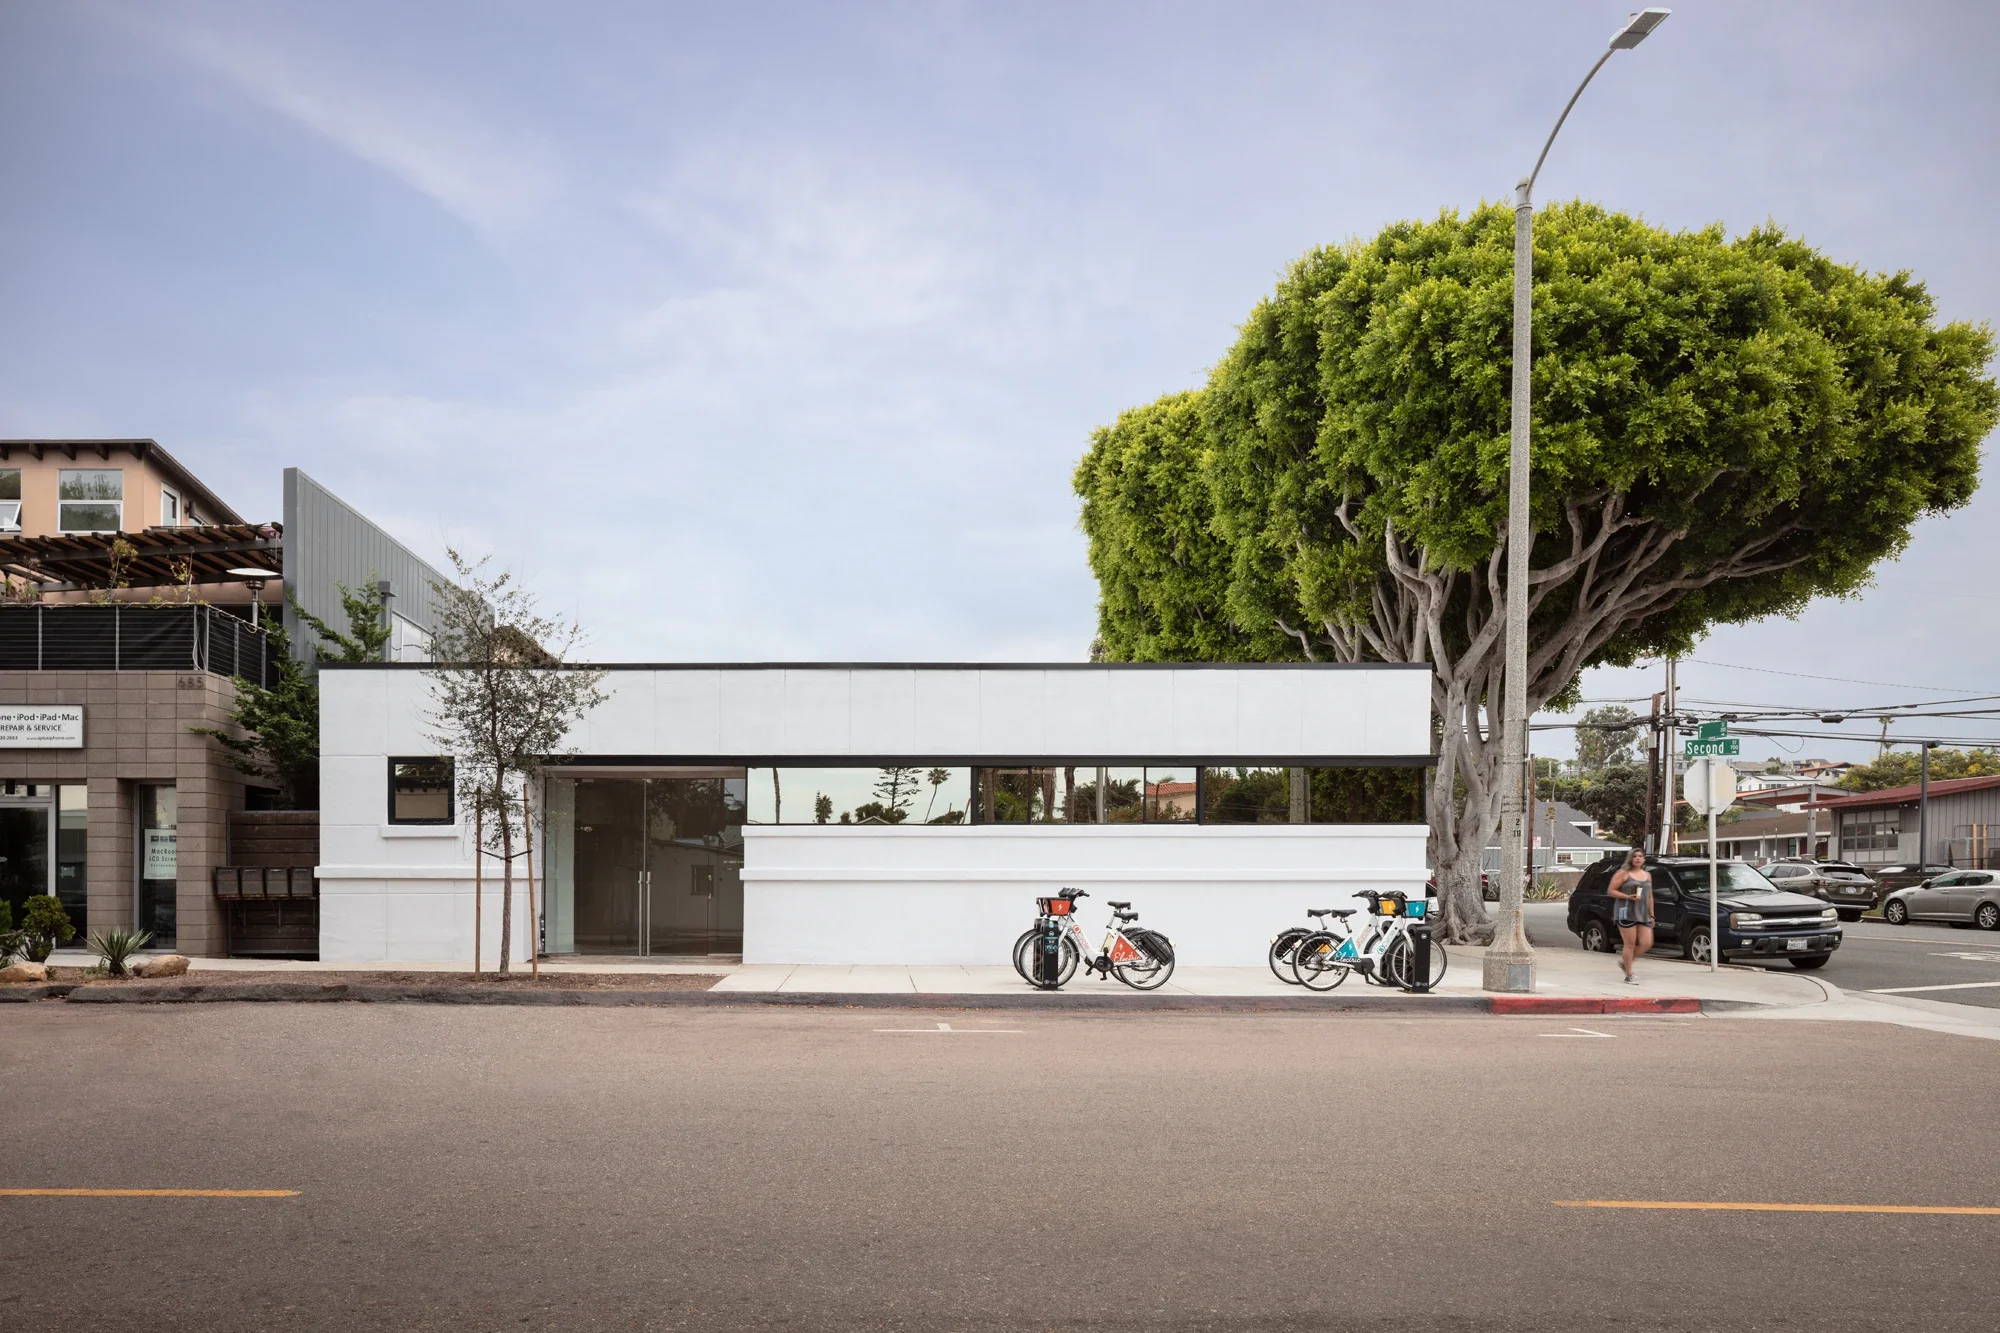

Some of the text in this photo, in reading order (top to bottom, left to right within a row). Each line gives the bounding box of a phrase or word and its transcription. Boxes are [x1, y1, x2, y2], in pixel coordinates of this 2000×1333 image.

[62, 713, 79, 721] Mac
[1699, 726, 1703, 738] F
[1687, 742, 1724, 754] Second
[1113, 951, 1141, 962] Electric
[1334, 951, 1361, 963] Electric
